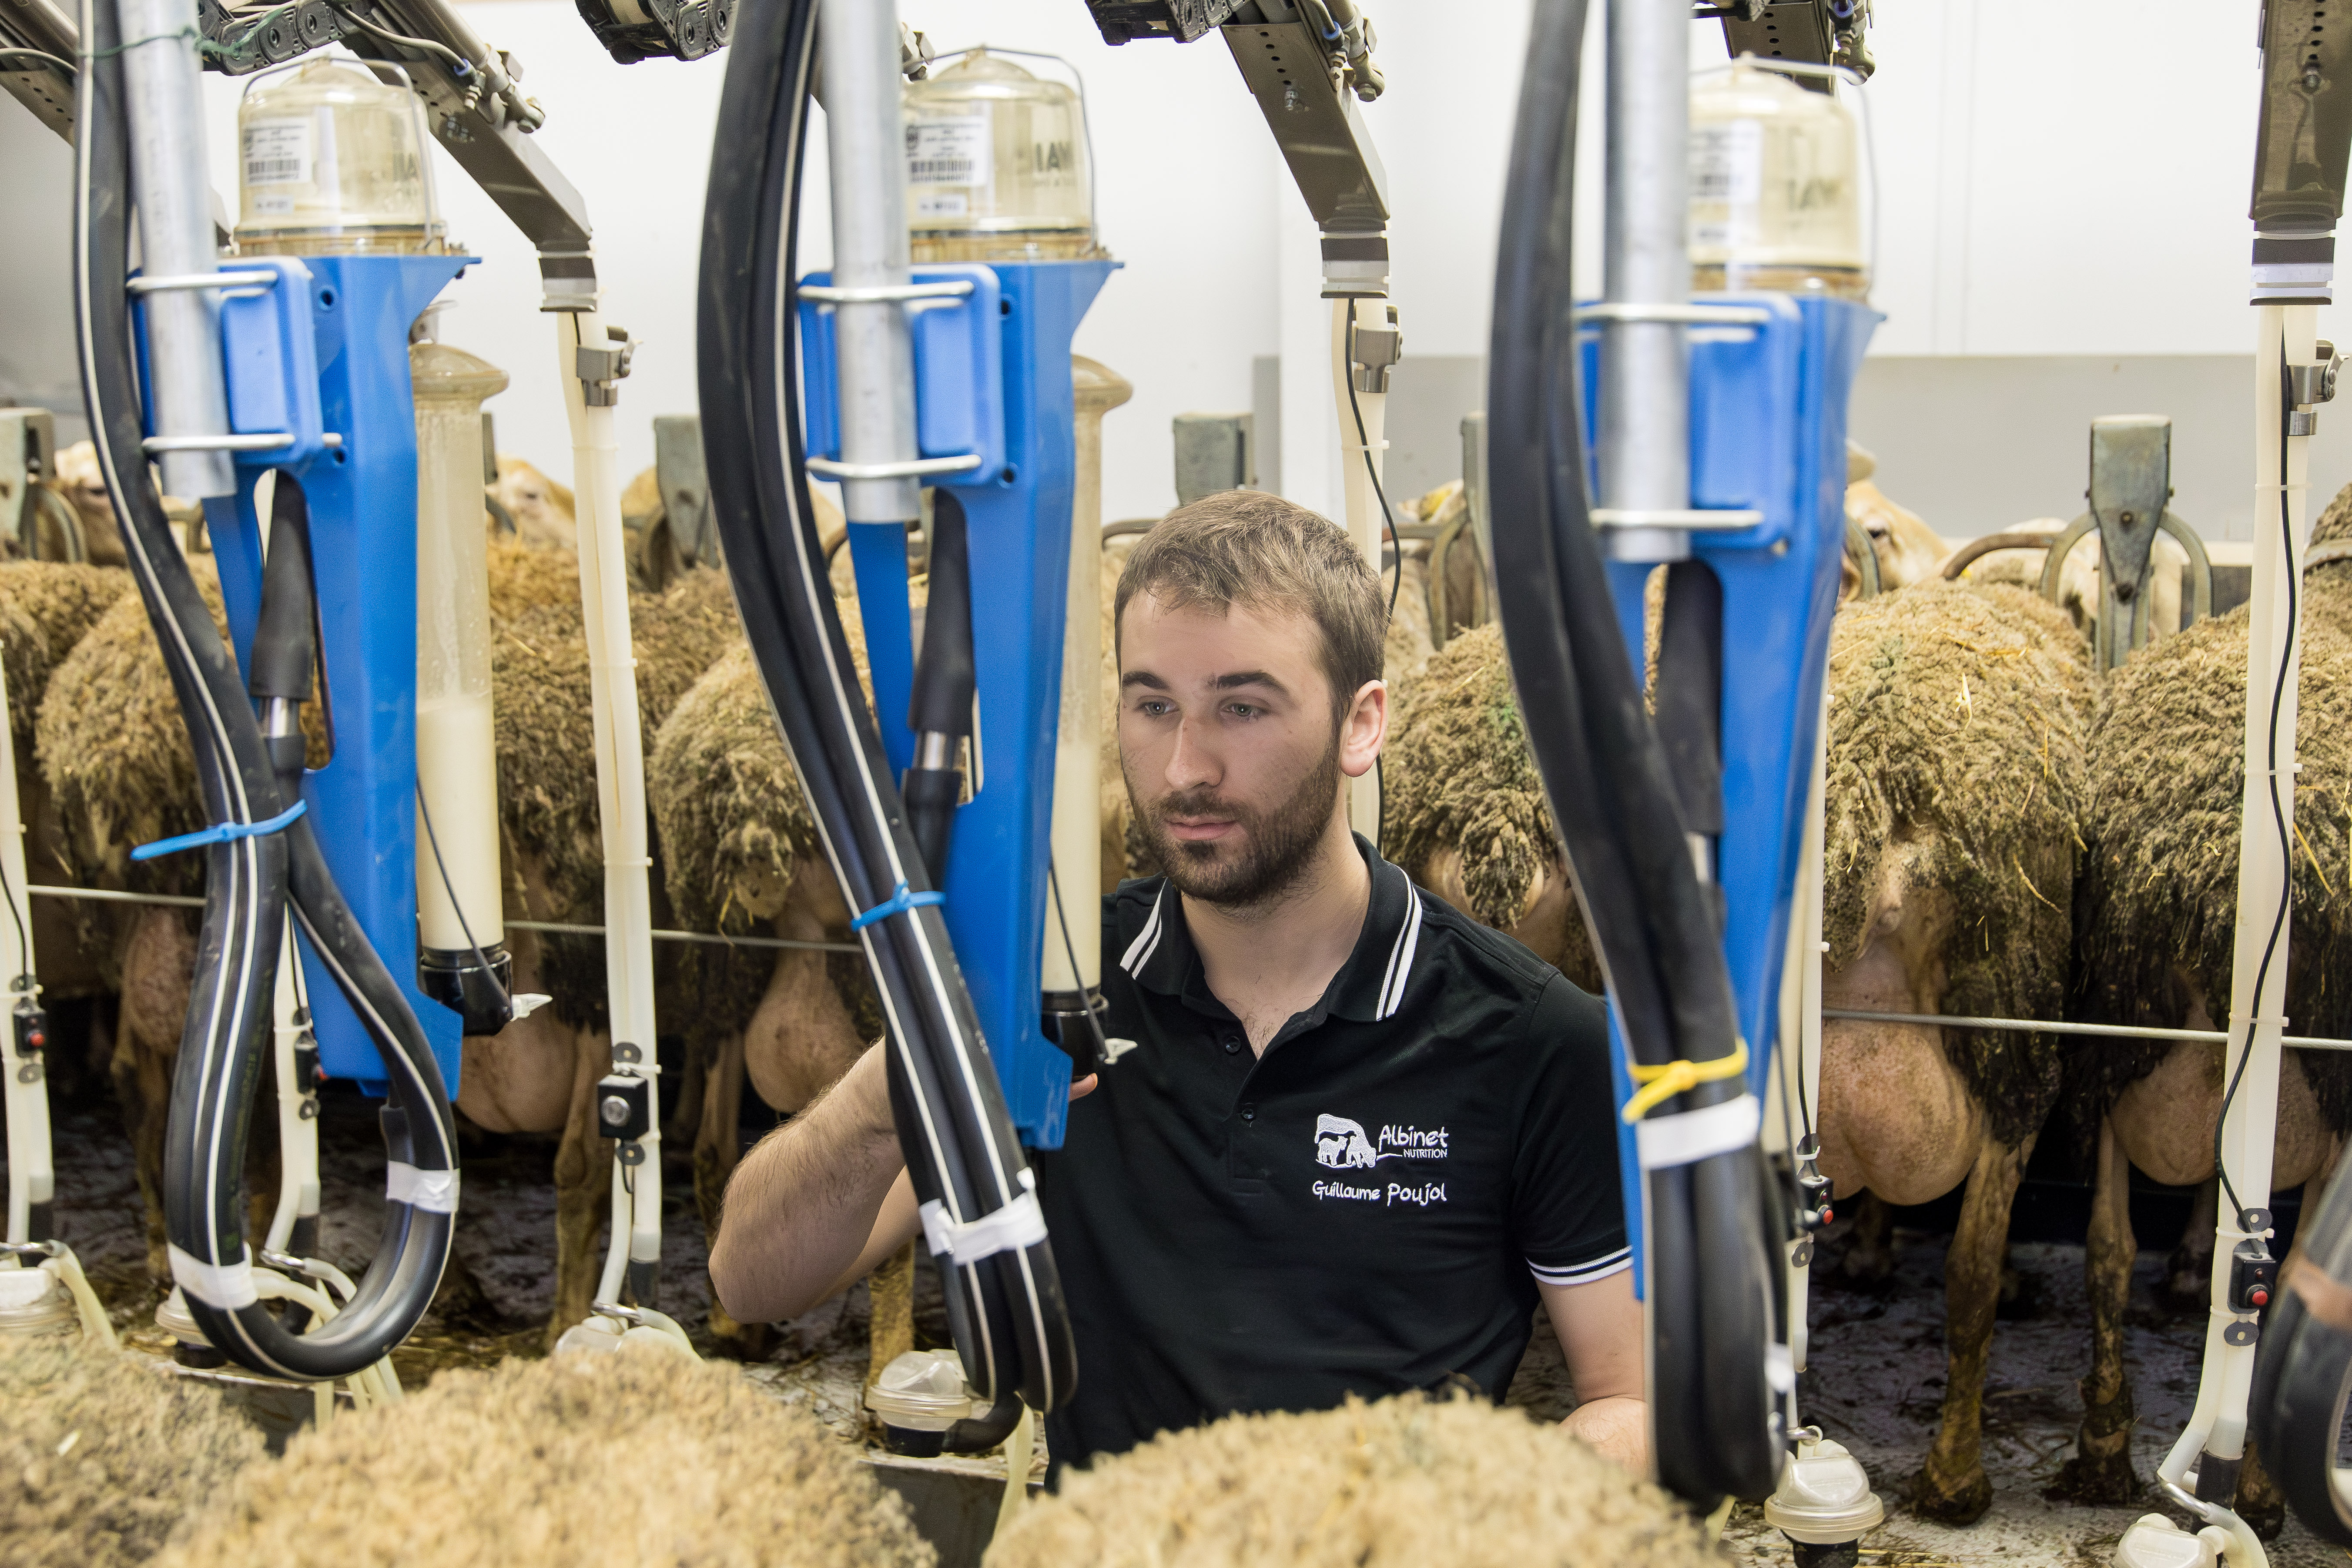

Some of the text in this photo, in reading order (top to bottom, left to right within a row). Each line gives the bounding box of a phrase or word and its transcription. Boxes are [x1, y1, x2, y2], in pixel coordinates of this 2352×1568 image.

[1379, 1125, 1448, 1152] Albinet
[1404, 1149, 1447, 1159] NUTRITION
[1313, 1180, 1447, 1206] Guillaume Poujol
